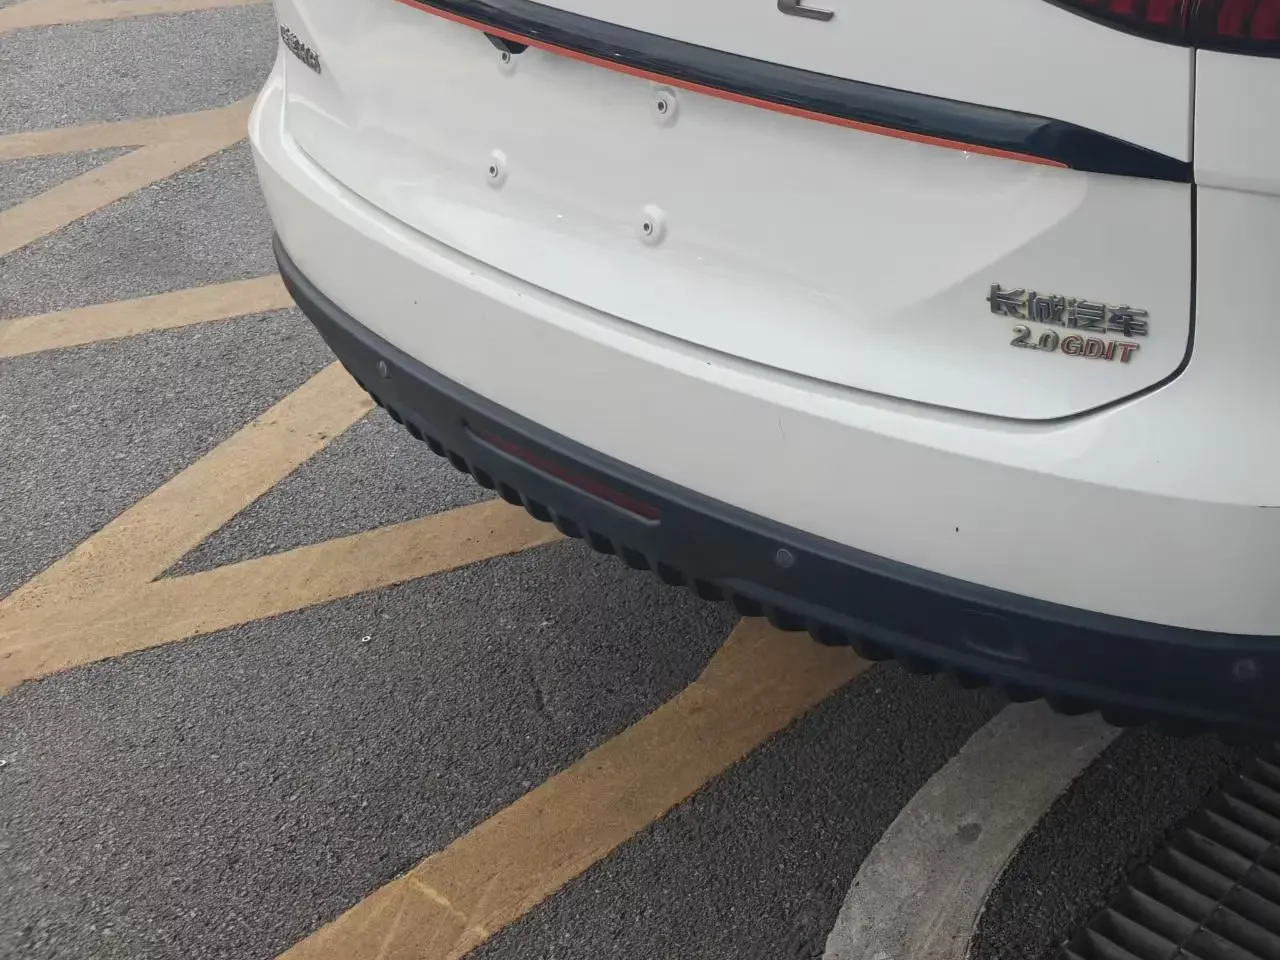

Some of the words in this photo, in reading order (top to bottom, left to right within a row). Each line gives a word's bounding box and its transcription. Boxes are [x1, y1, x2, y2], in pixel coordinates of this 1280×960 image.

[986, 282, 1150, 337] 长城汽车
[1010, 324, 1141, 364] 2.0GDIT
